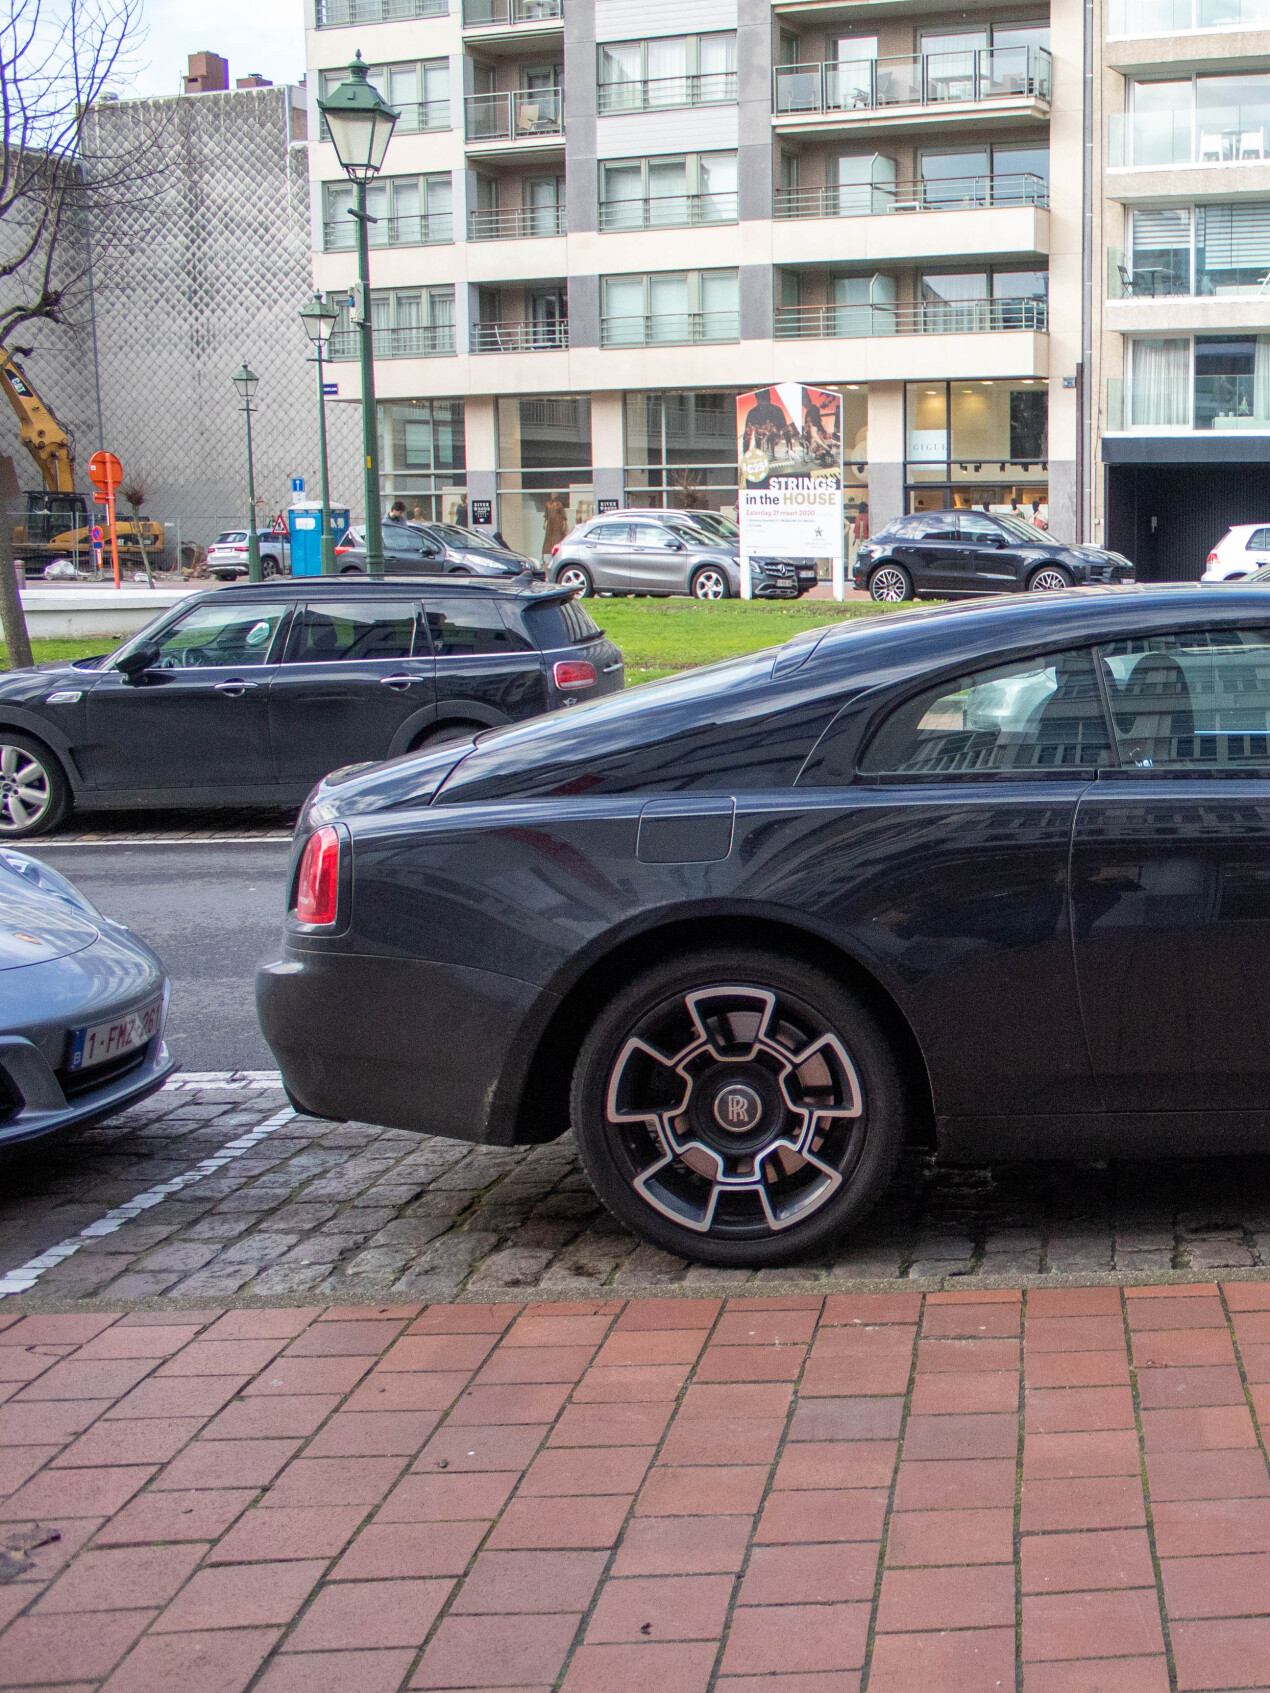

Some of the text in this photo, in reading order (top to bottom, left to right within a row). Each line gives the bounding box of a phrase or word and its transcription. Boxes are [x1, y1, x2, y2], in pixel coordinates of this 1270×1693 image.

[11, 377, 27, 393] CAT
[769, 477, 837, 490] STRINGS
[745, 492, 836, 505] in the HOUSE
[728, 1095, 749, 1122] RR
